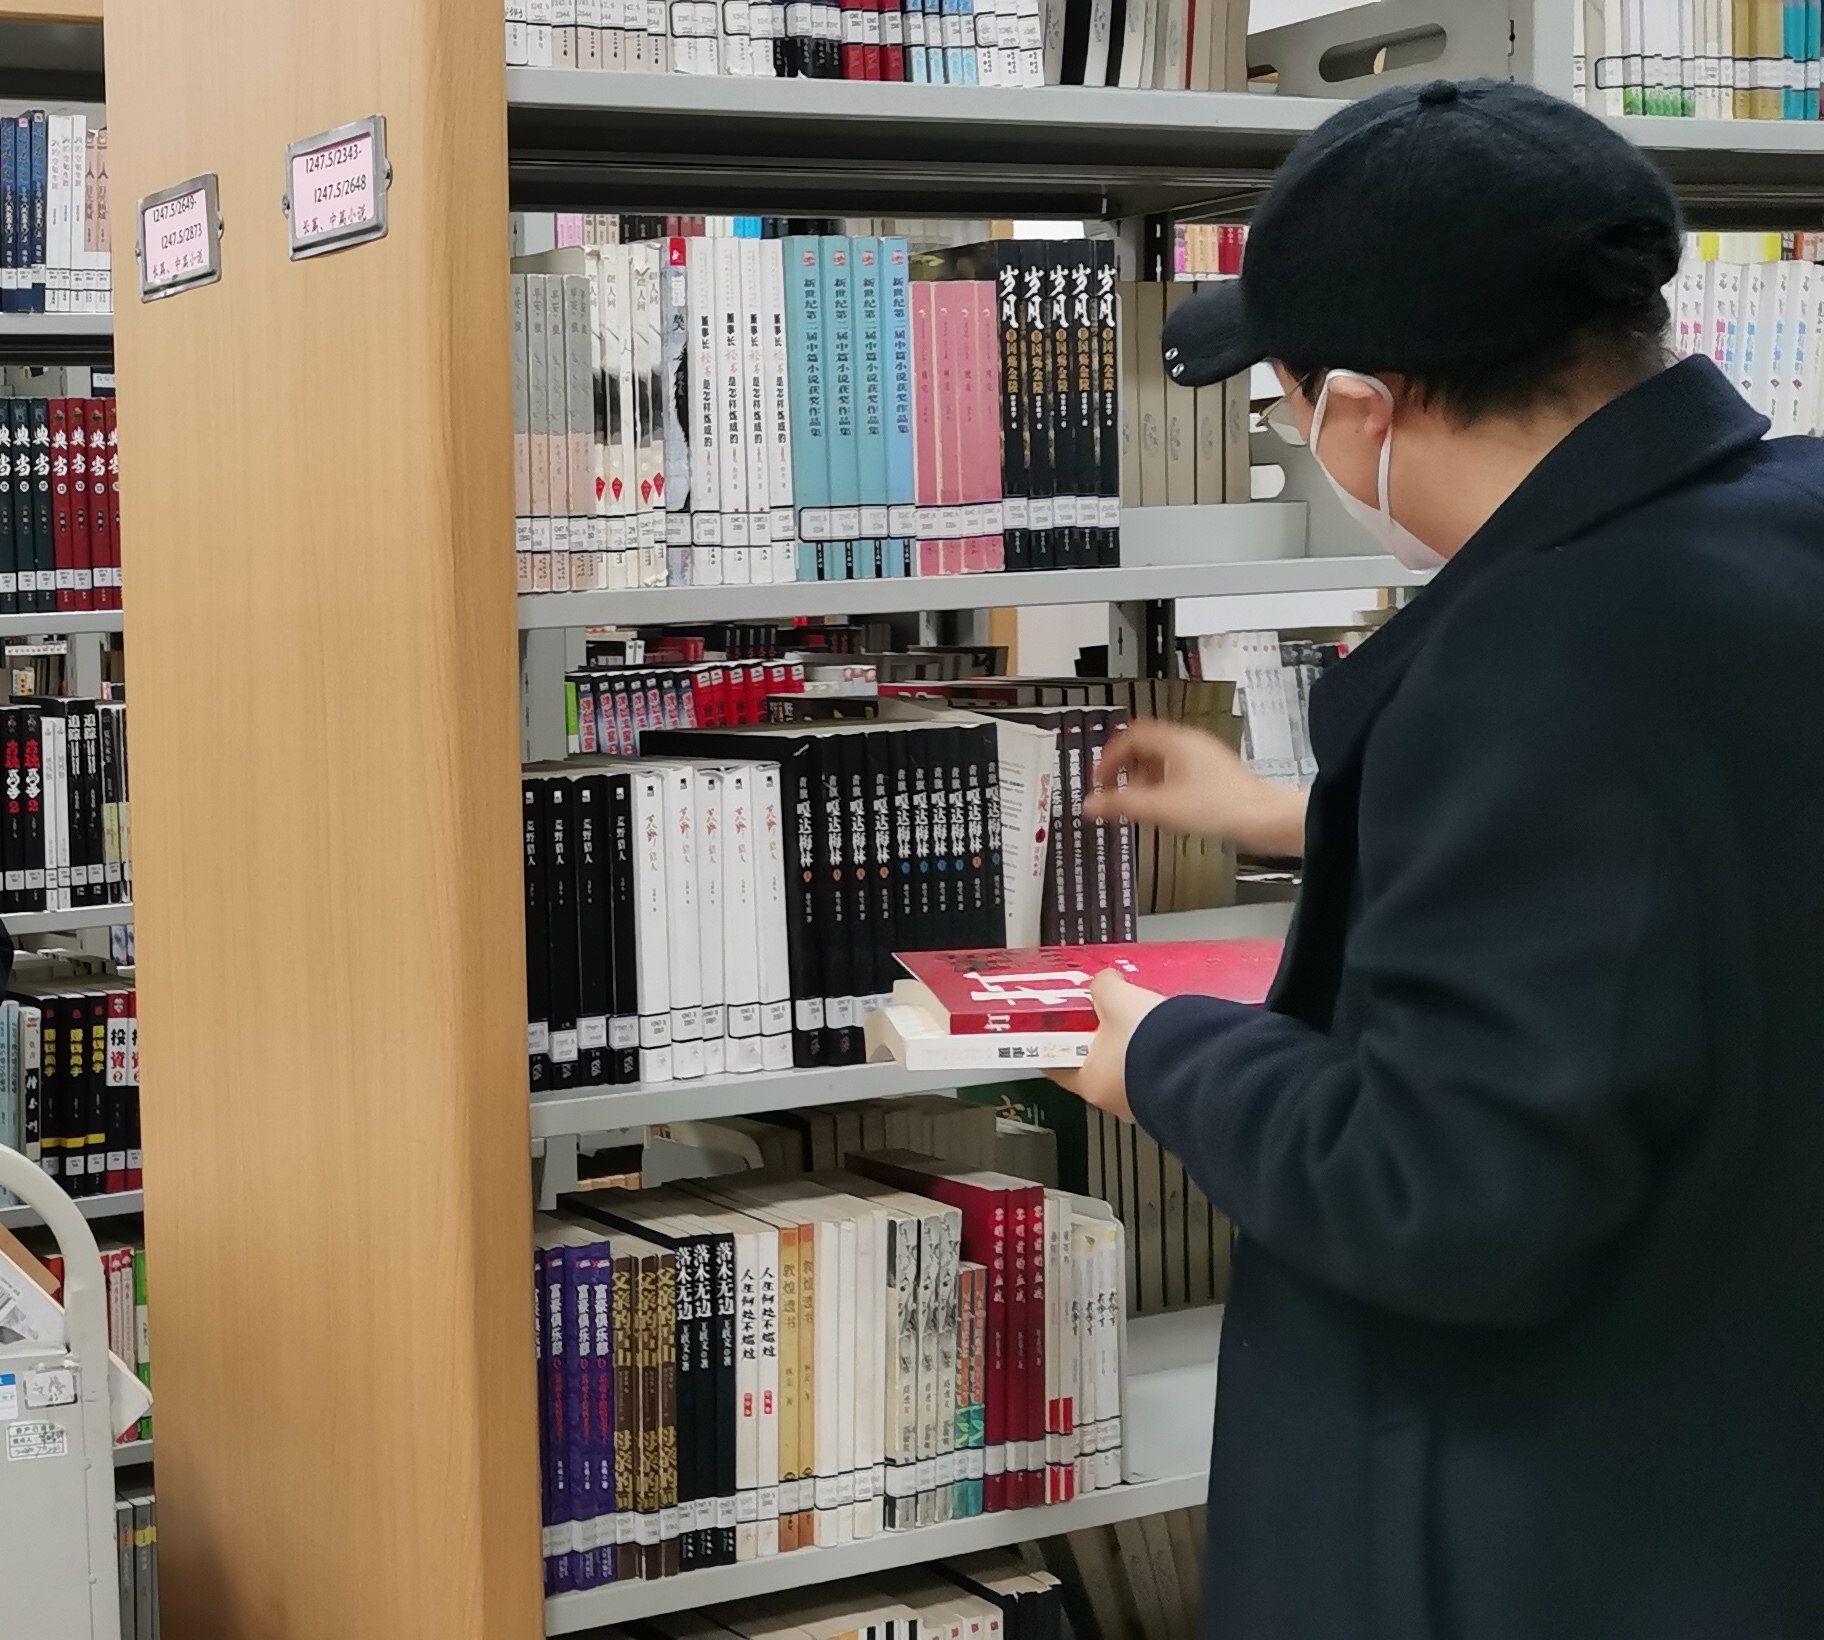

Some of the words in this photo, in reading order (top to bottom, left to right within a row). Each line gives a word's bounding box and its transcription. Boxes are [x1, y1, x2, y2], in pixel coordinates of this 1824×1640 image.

[999, 264, 1019, 328] 岁月
[1024, 265, 1045, 330] 岁月
[1048, 264, 1069, 328] 岁月
[1071, 262, 1092, 327] 岁月
[1096, 263, 1117, 328] 岁月
[13, 424, 31, 477] 典当
[32, 424, 50, 477] 典当
[52, 429, 68, 477] 典当
[71, 426, 86, 474] 典当
[89, 428, 106, 477] 典当
[676, 1246, 693, 1320] 落木无边
[693, 1244, 712, 1318] 落木无边
[716, 1242, 734, 1315] 落木无边
[549, 1283, 563, 1356] 富豪俱乐部
[577, 1283, 590, 1356] 富豪俱乐部
[594, 1283, 609, 1356] 富豪俱乐部
